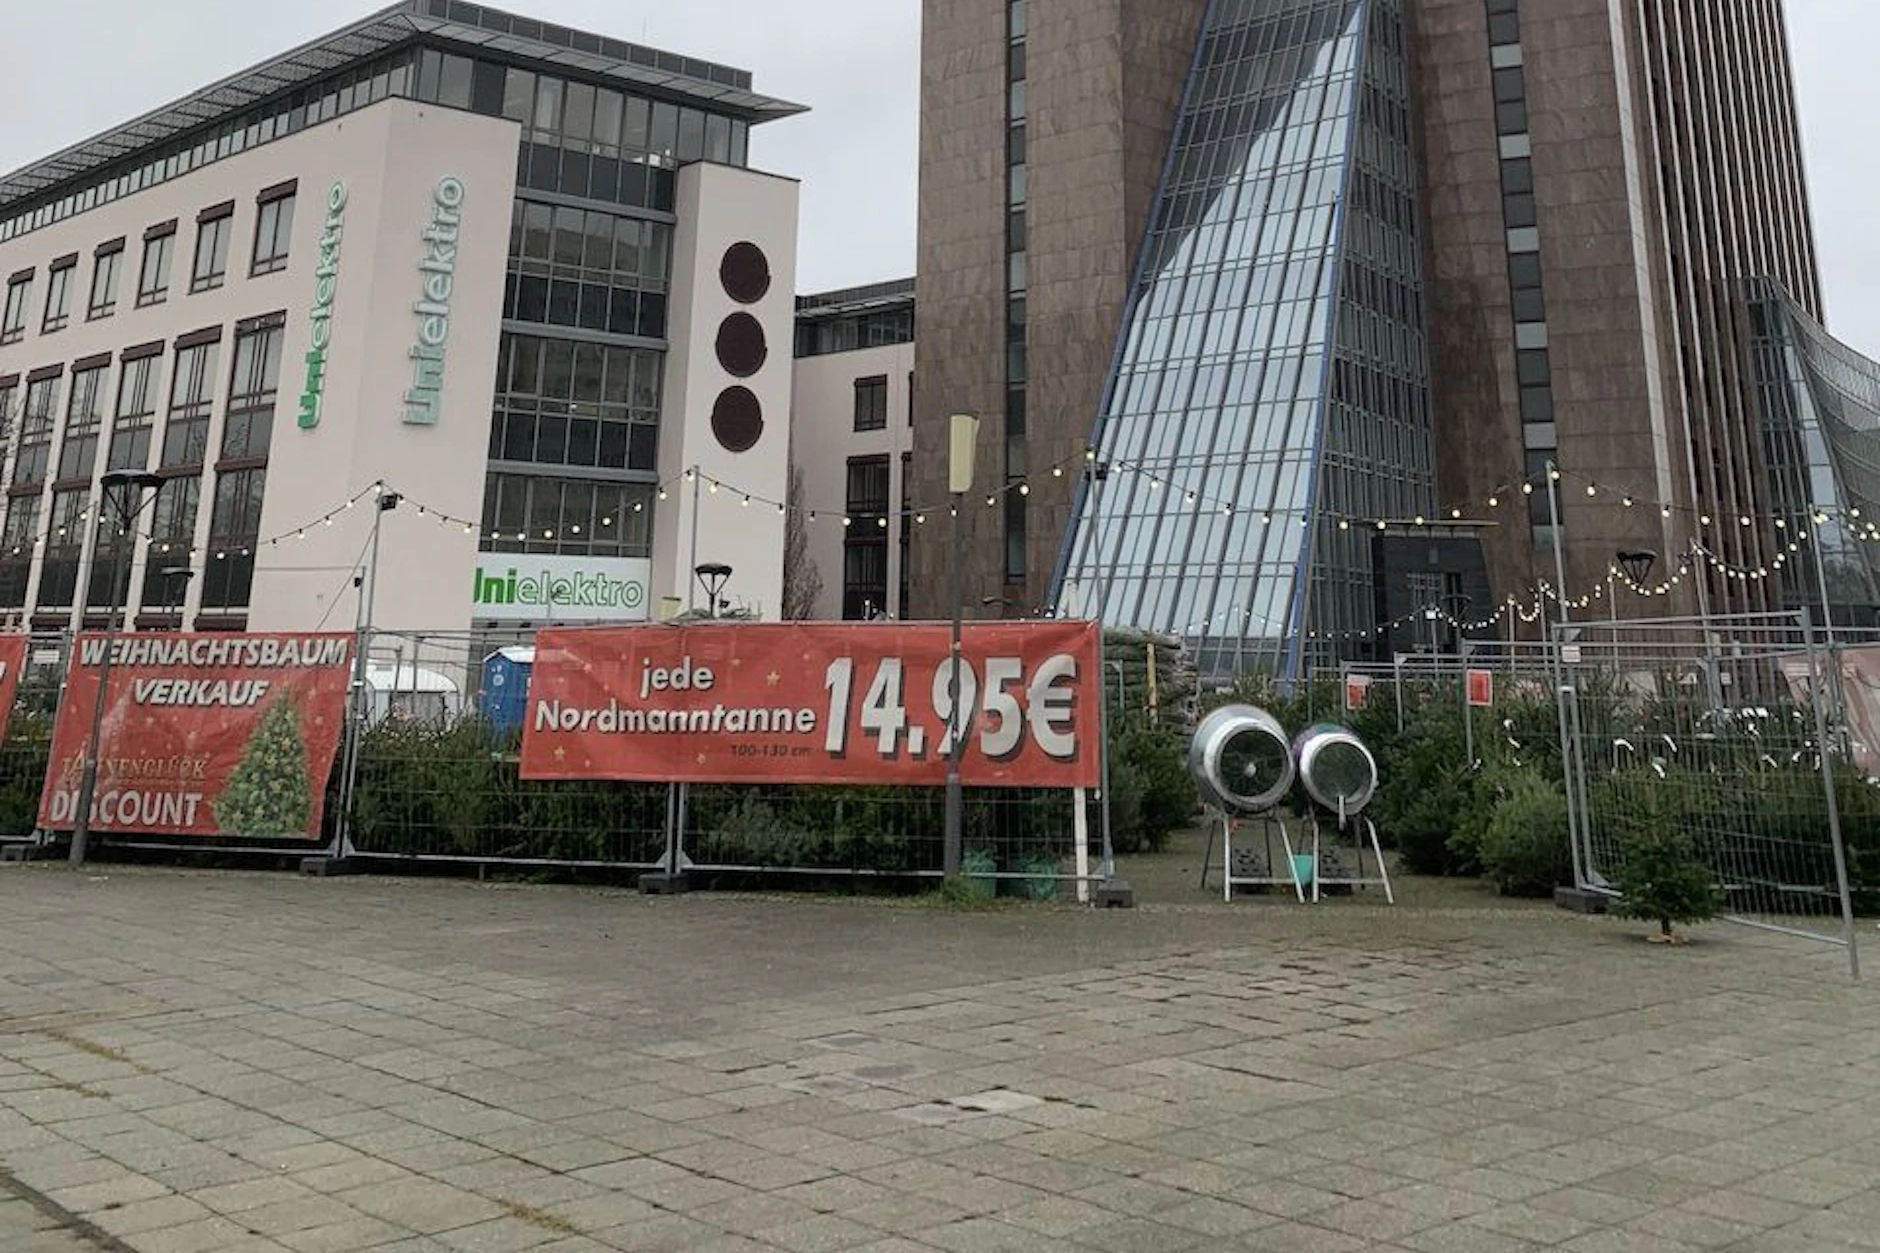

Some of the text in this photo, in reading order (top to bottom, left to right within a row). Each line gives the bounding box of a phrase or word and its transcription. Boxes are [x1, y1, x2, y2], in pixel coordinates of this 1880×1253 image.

[298, 181, 347, 429] Unielektro
[402, 176, 464, 425] Unielektro
[79, 639, 348, 666] WEIHNACHTSBAUM
[133, 678, 269, 706] VERKAUF
[640, 657, 714, 698] jede
[534, 699, 816, 734] Nordmanntanne
[823, 654, 1078, 758] 14.95€
